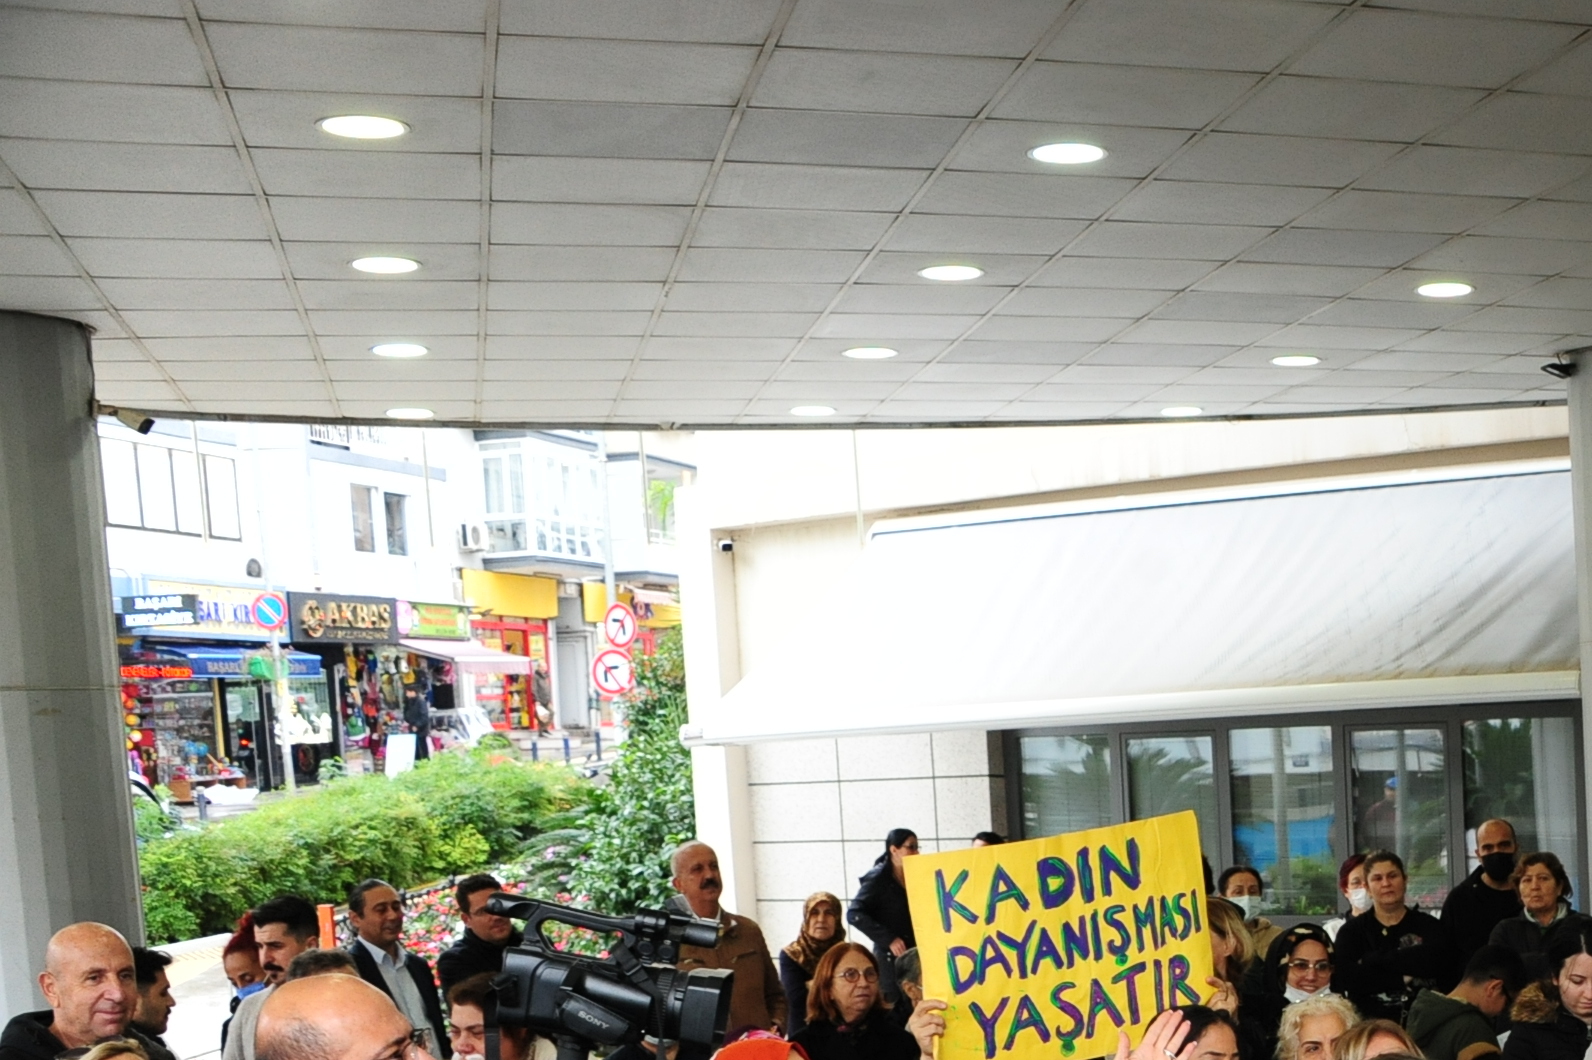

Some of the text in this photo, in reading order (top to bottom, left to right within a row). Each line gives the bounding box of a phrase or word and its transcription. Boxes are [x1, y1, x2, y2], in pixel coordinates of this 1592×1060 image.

[934, 837, 1141, 933] KADIN
[947, 888, 1202, 996] DAYANIŞMASI
[577, 1010, 610, 1030] SONY
[968, 954, 1201, 1060] YAŞATIR
